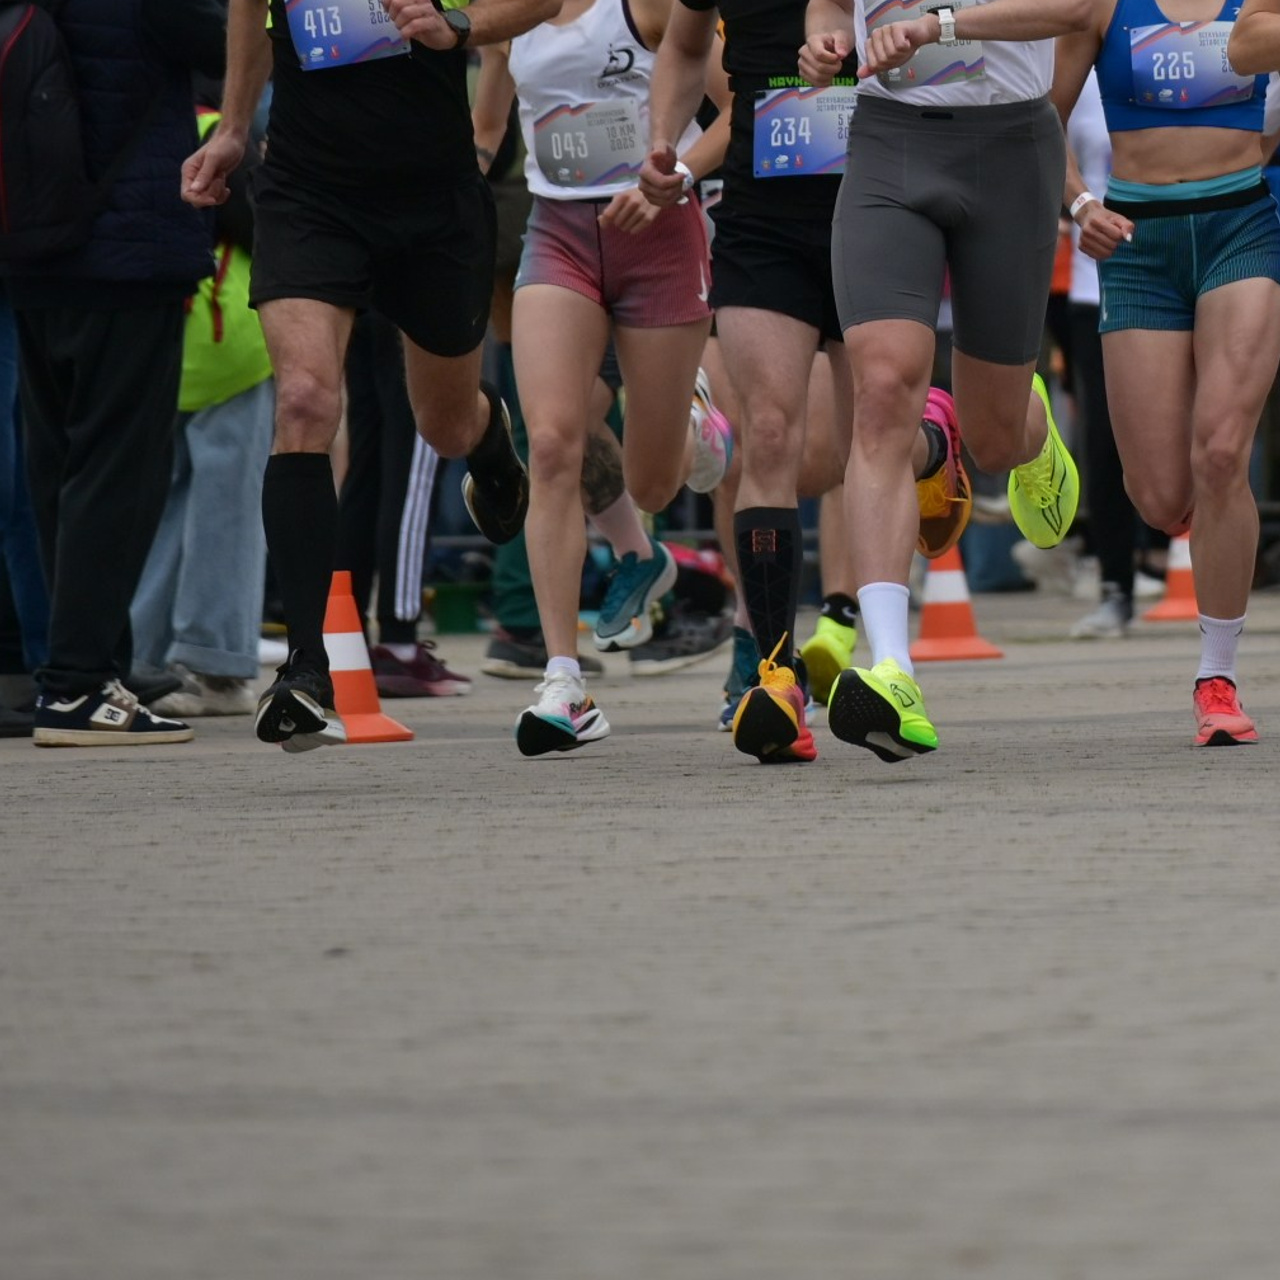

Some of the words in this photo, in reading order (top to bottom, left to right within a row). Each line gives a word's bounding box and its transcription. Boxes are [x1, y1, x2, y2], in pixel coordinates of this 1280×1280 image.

[368, 0, 375, 11] 5
[304, 6, 342, 38] 413
[1152, 51, 1195, 80] 225
[1221, 48, 1227, 60] 5
[771, 117, 811, 146] 234
[838, 114, 844, 125] 5
[551, 131, 588, 159] 043
